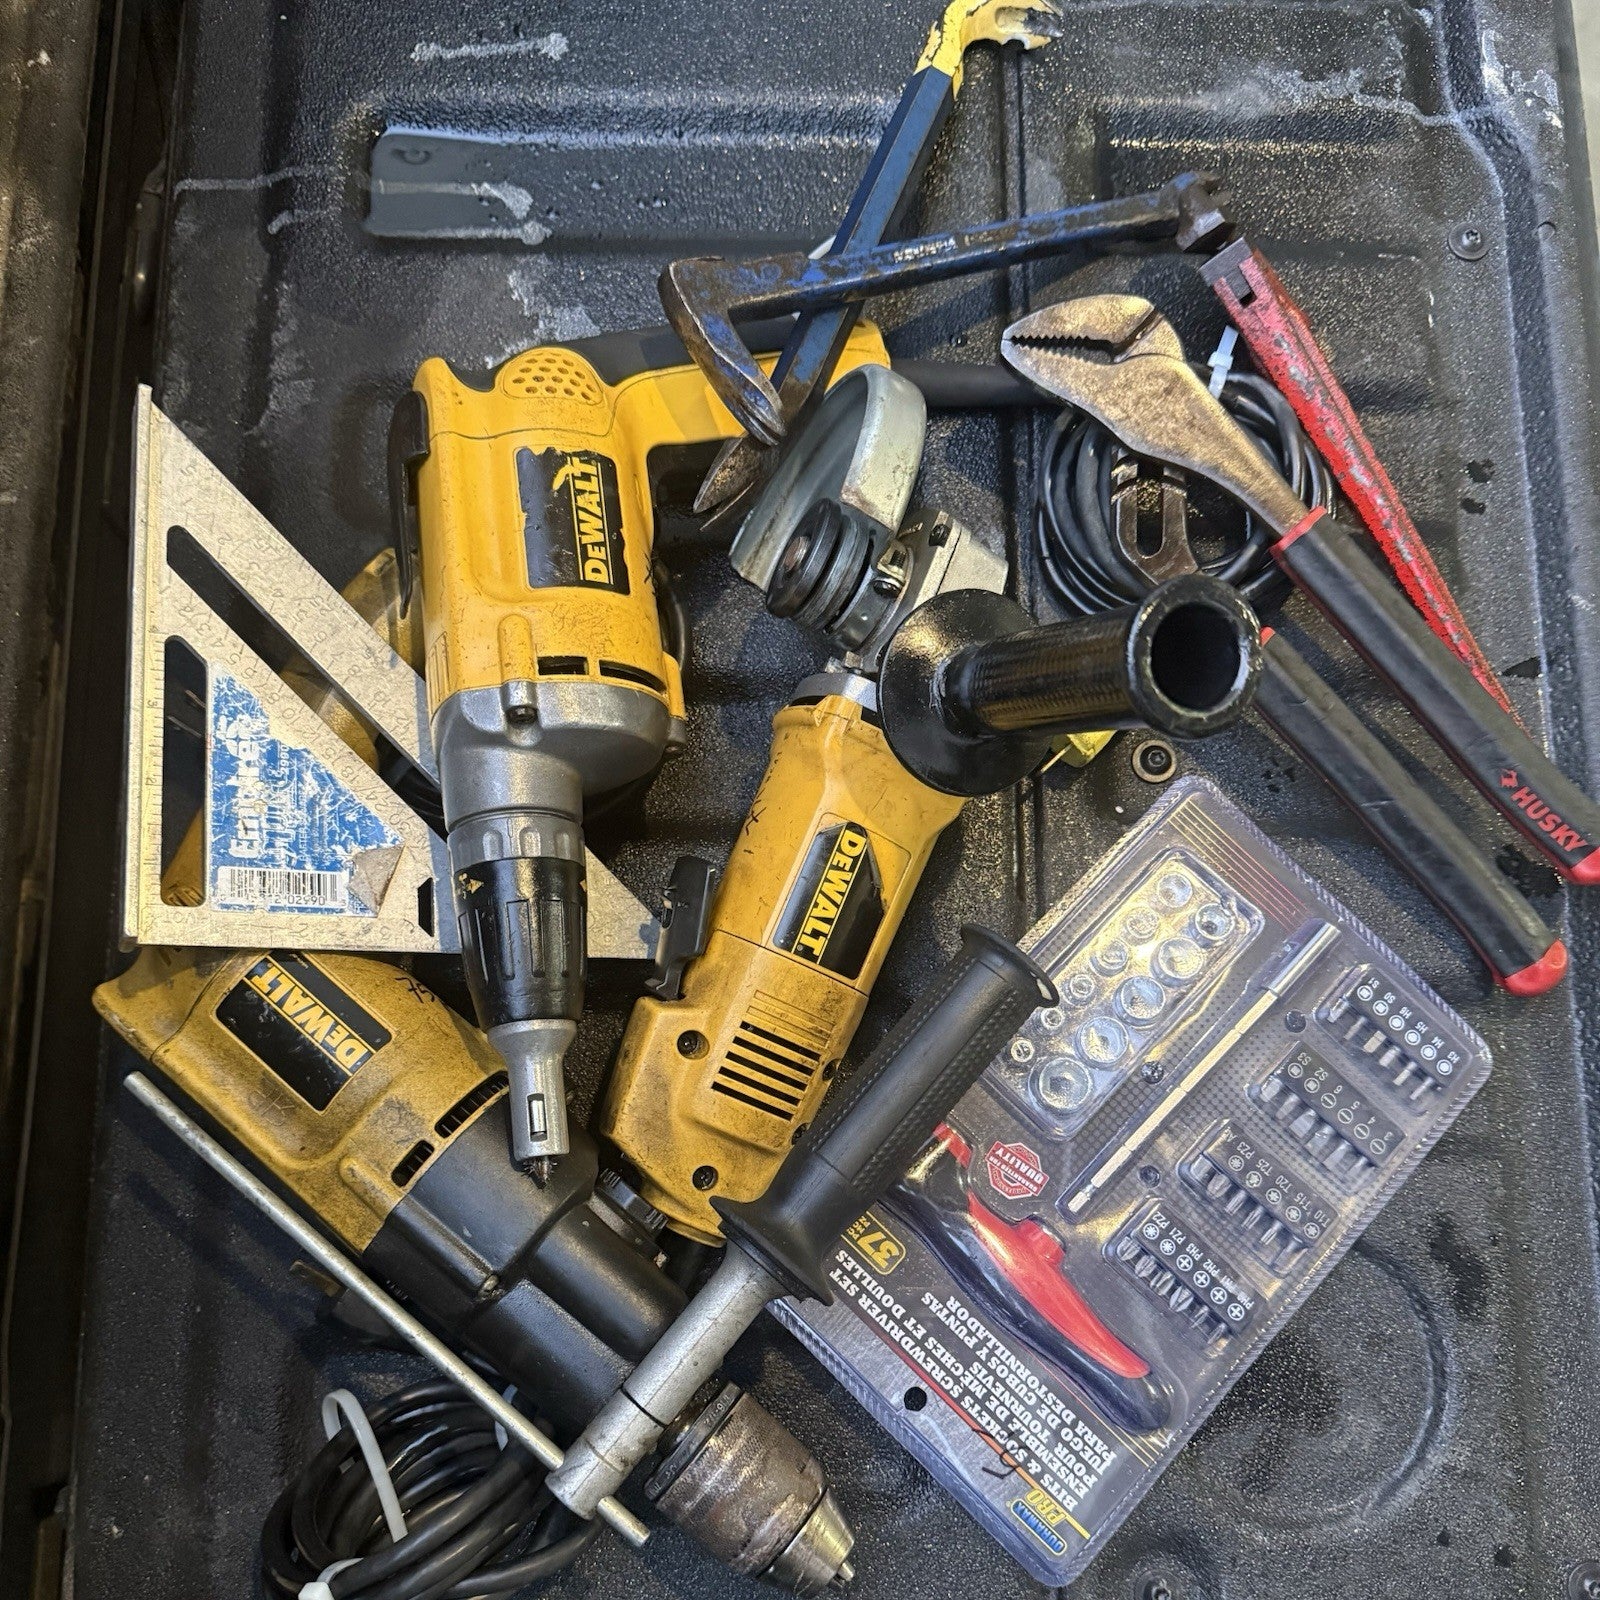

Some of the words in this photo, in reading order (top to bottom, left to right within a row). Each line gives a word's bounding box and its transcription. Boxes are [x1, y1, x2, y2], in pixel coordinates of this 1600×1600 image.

[571, 457, 609, 583] DEWALT
[1511, 786, 1588, 852] HUSKY
[798, 830, 867, 957] DEWALT
[1367, 976, 1379, 988] S1
[1383, 990, 1396, 1003] S0
[252, 966, 368, 1069] DEWALT
[1399, 1005, 1412, 1018] H6
[1415, 1020, 1428, 1033] H5
[1431, 1035, 1444, 1048] H4
[1296, 1050, 1312, 1066] S3
[1447, 1050, 1460, 1063] H3
[1314, 1065, 1329, 1081] S2
[1235, 1139, 1255, 1159] PZ3
[994, 1145, 1045, 1184] QUALITY
[1255, 1156, 1274, 1176] T25
[1273, 1173, 1293, 1193] T20
[1293, 1190, 1313, 1210] T15
[1151, 1210, 1170, 1229] PZ2
[1312, 1208, 1332, 1227] T10
[858, 1226, 900, 1267] 37
[1168, 1226, 1186, 1244] PZ1
[1184, 1241, 1204, 1260] PH3
[1201, 1257, 1221, 1276] PH2
[829, 1266, 859, 1296] SET
[834, 1249, 906, 1317] DOUILLES
[903, 1315, 926, 1338] ET
[921, 1291, 978, 1346] PUNTAS
[856, 1294, 963, 1397] SCREWDRIVER
[973, 1342, 992, 1361] Y
[920, 1335, 988, 1400] MÈCHES
[943, 1296, 1076, 1423] DESTORNILLADOR
[987, 1355, 1038, 1404] CUBOS
[968, 1361, 1051, 1441] TOURNEVIS
[985, 1395, 1010, 1419] DE
[960, 1394, 1028, 1461] SOCKETS
[1035, 1403, 1060, 1427] DE
[1059, 1425, 1109, 1473] JUEGO
[1073, 1420, 1116, 1462] PARA
[1007, 1417, 1090, 1496] ENSEMBLE
[1023, 1456, 1043, 1476] &
[1052, 1442, 1098, 1486] POUR
[1040, 1473, 1078, 1509] BITS
[1024, 1486, 1065, 1527] PRO
[1013, 1503, 1063, 1551] DURAMAX
